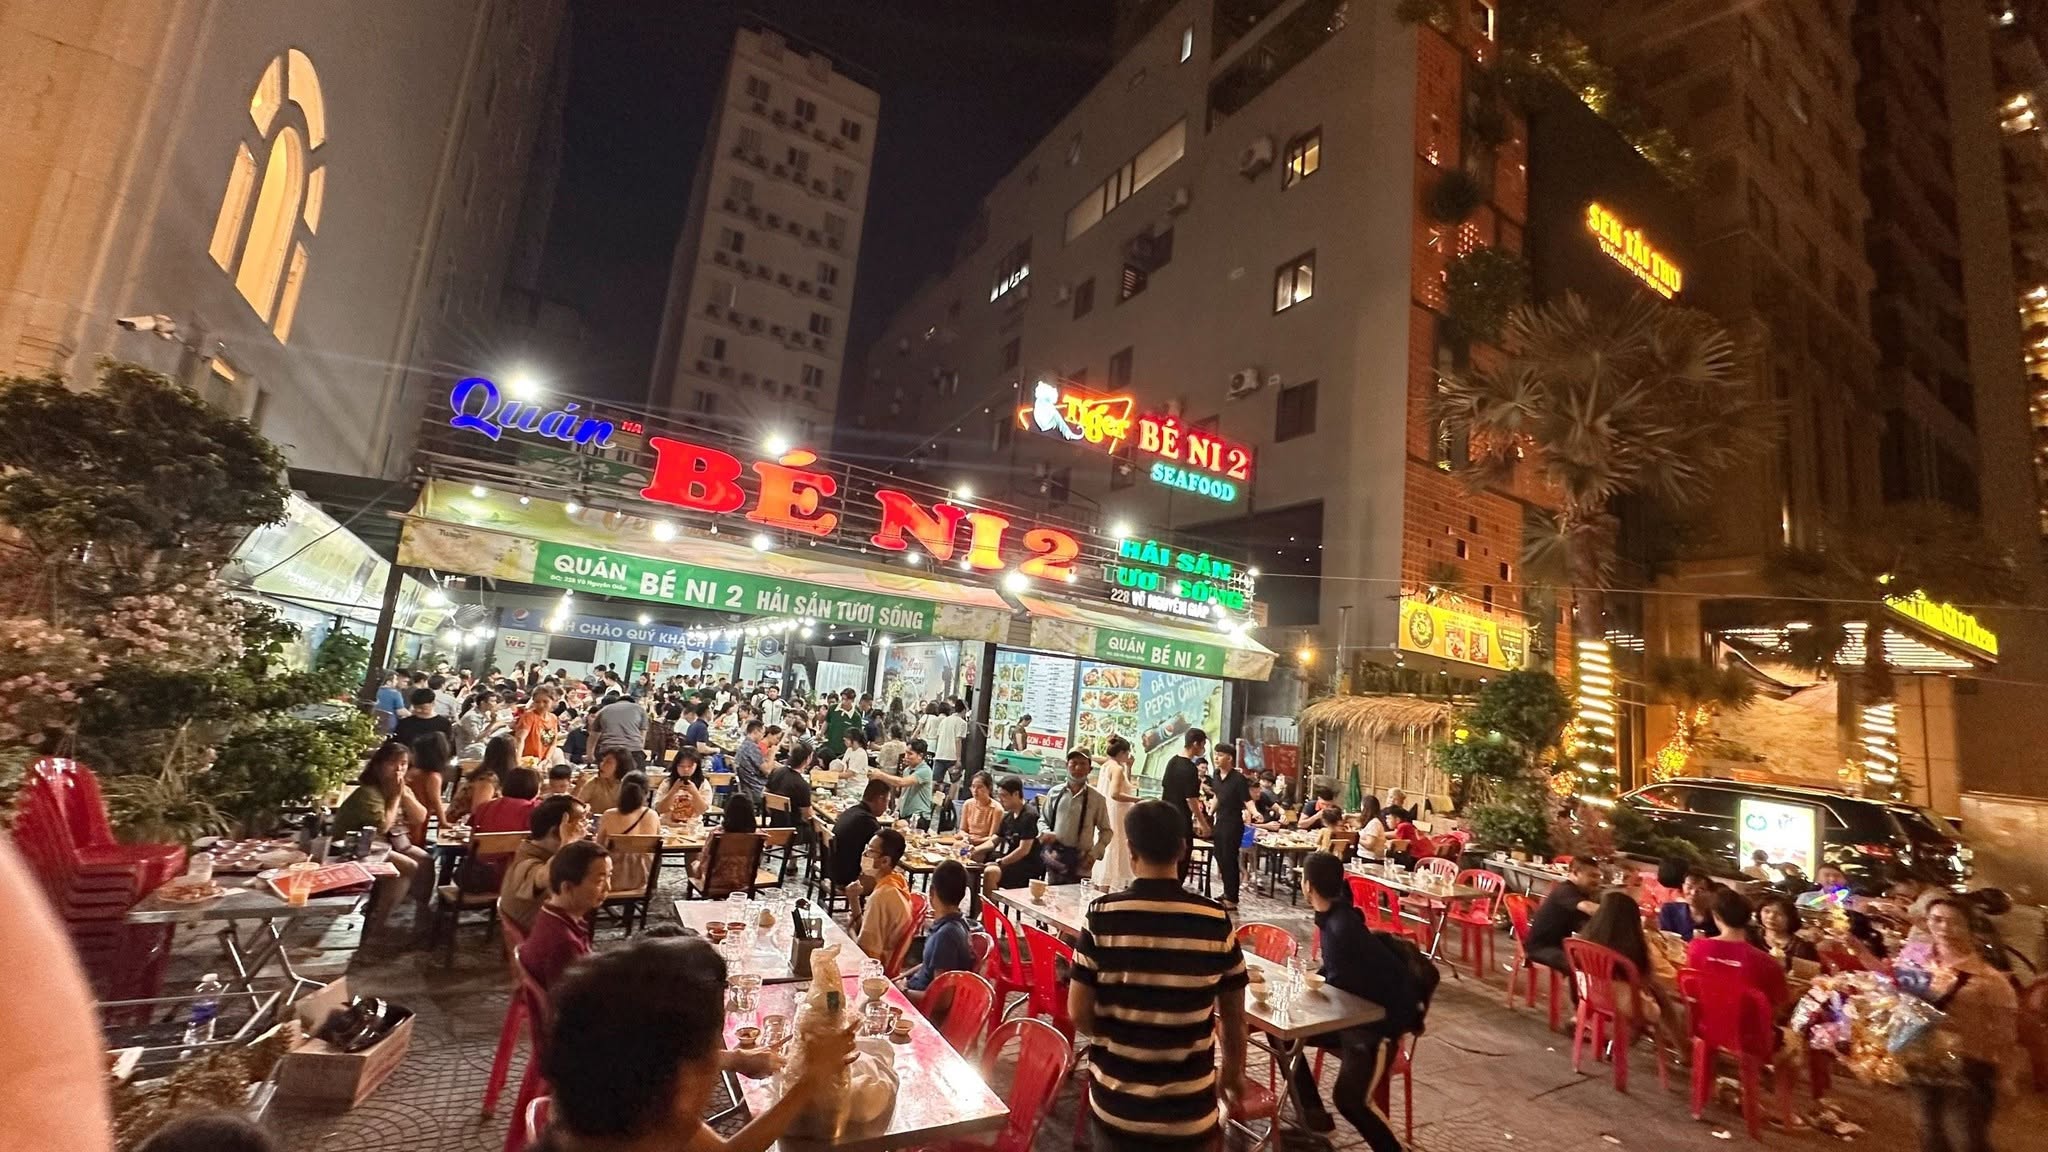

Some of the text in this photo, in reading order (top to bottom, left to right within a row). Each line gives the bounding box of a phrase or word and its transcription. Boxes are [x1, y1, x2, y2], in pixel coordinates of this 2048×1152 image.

[1587, 203, 1622, 248] SEN
[450, 377, 617, 449] Quán
[1063, 394, 1130, 443] Tiger
[1138, 419, 1247, 480] BÉ NI 2
[1150, 462, 1236, 502] SEAFOOD
[640, 436, 838, 537] BÉ
[870, 489, 1010, 570] NI
[1019, 529, 1080, 582] 2
[554, 555, 924, 630] QUÁN BÉ NI 2 HẢI SẢN TƯƠI SỐNG
[1110, 588, 1130, 603] 228
[505, 639, 526, 648] WC
[579, 622, 623, 638] CHÀO
[626, 627, 656, 642] QUÝ
[1108, 636, 1146, 655] QUÁN
[1151, 644, 1171, 665] BÉ
[1174, 650, 1191, 669] NI
[1195, 654, 1206, 670] 2
[1144, 690, 1175, 719] PEPSI
